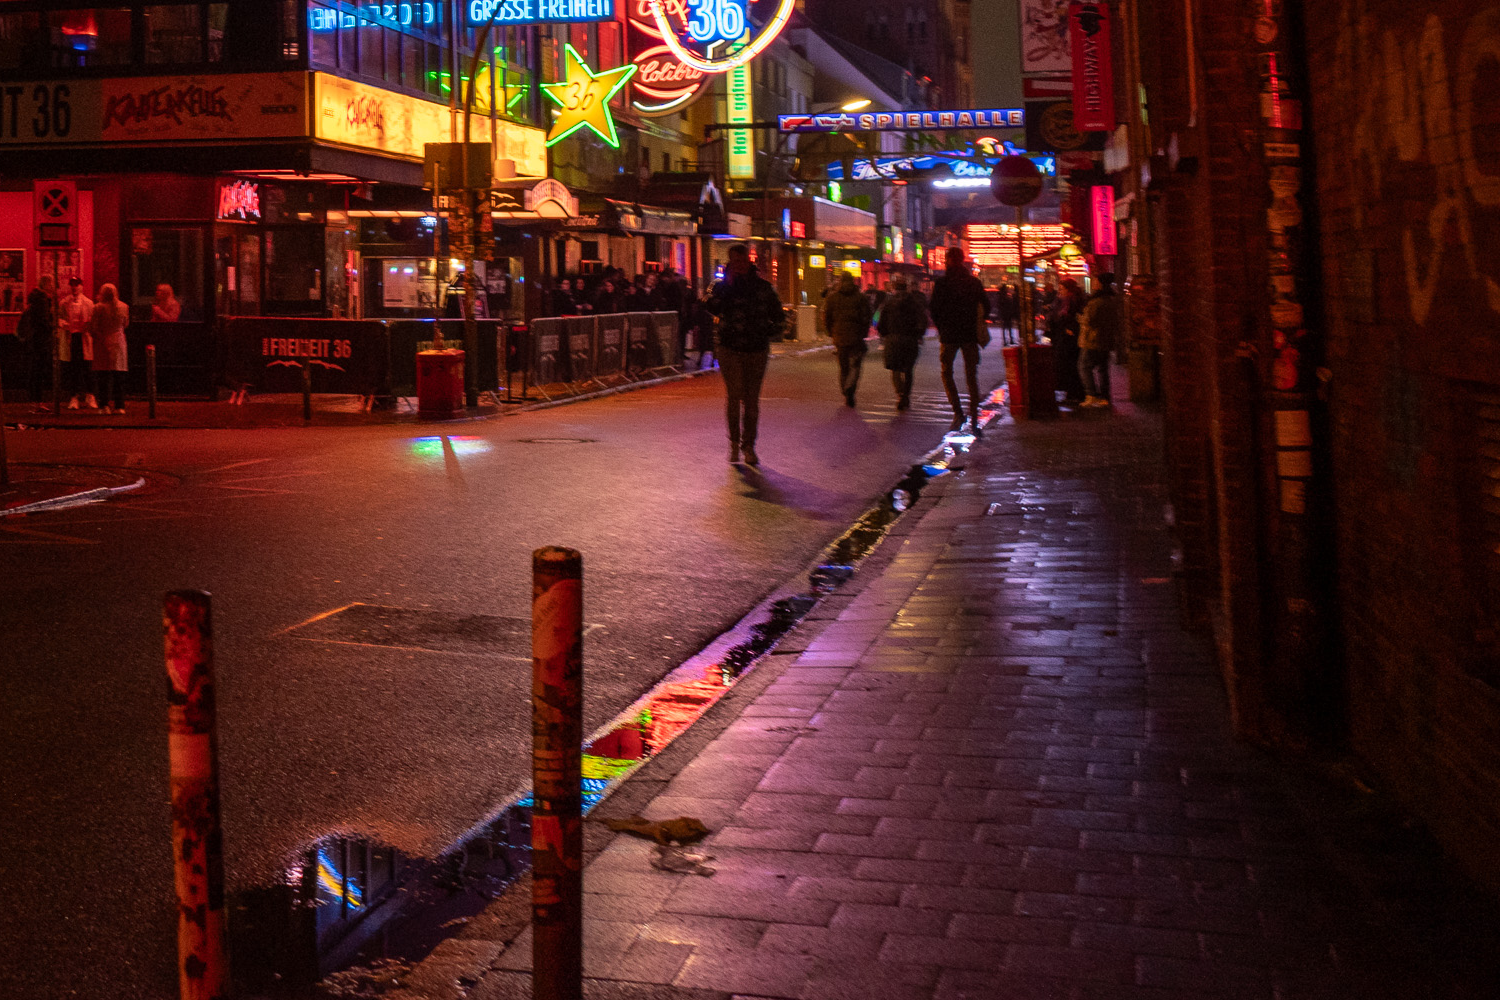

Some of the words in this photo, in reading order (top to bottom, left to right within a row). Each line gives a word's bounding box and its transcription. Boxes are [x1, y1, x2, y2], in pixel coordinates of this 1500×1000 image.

[1082, 37, 1100, 112] HIGHWAY
[33, 85, 71, 137] 36
[564, 78, 599, 111] 36
[859, 110, 1024, 131] SPIELHALLE
[333, 339, 352, 359] 36
